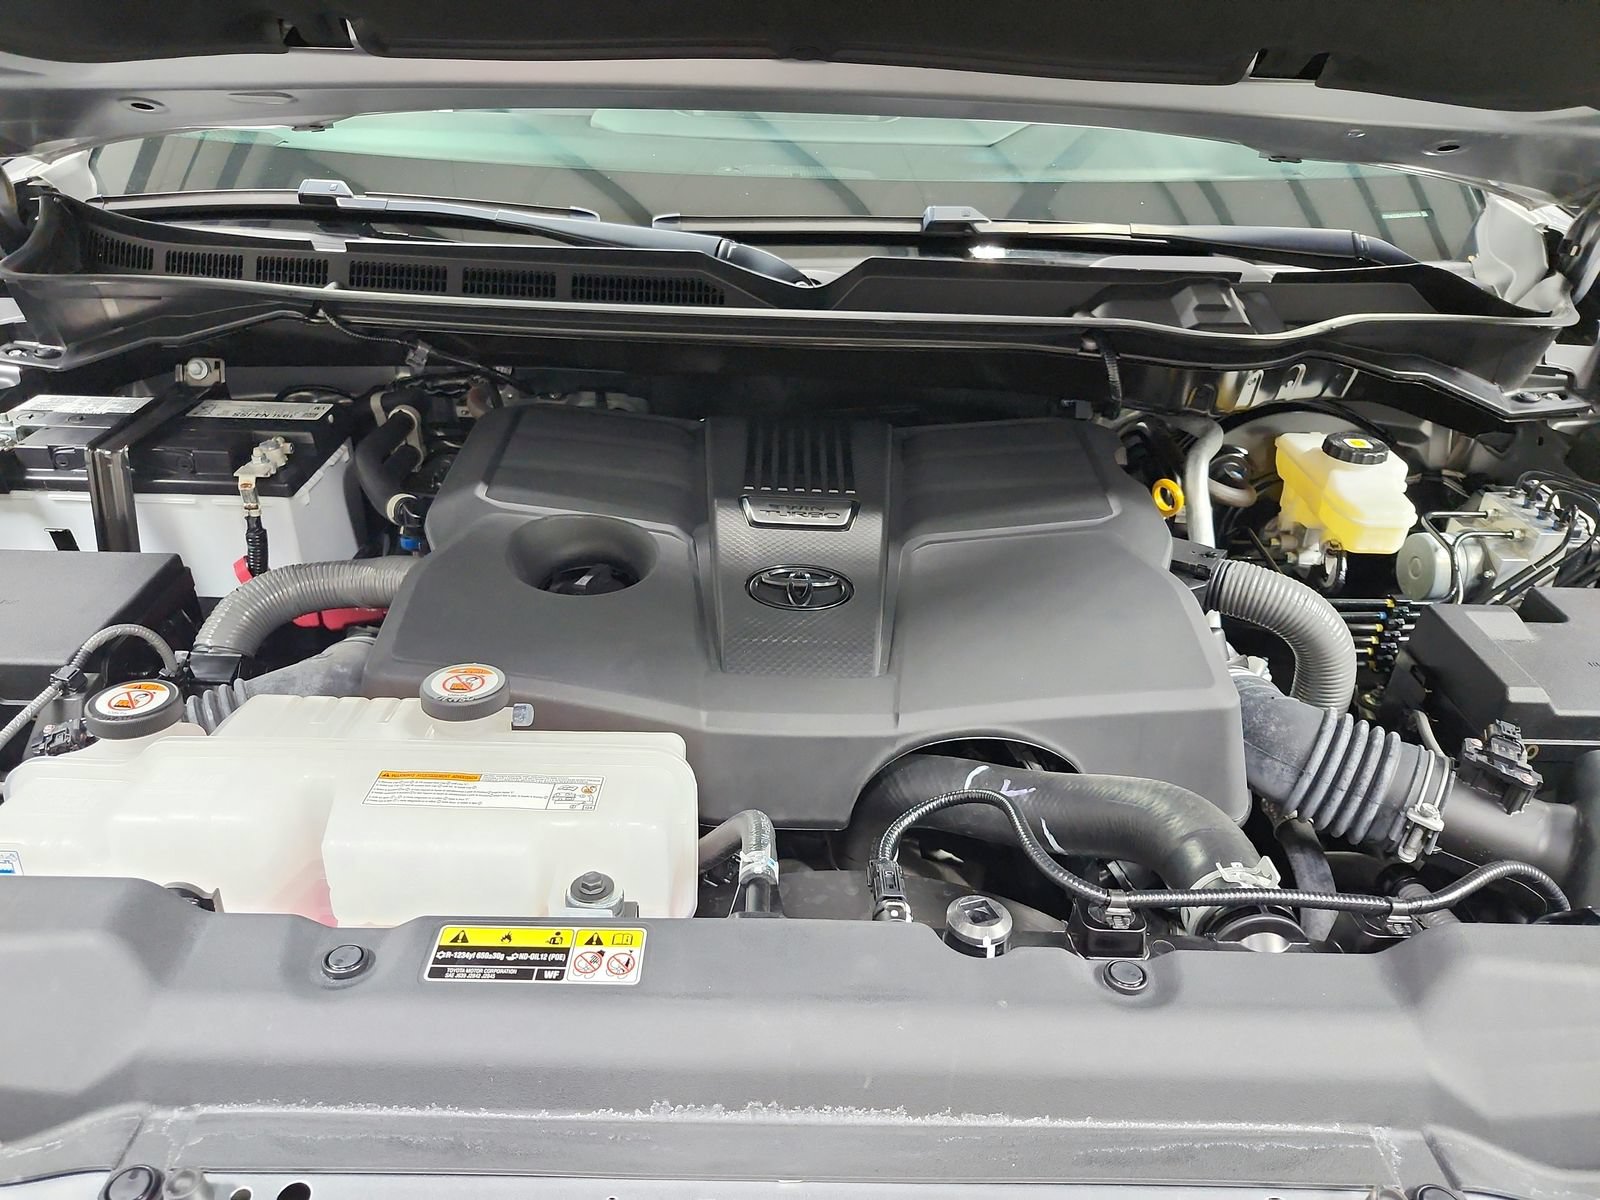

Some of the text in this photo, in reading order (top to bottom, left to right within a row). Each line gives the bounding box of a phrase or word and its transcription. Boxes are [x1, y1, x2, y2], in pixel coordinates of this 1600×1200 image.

[768, 503, 825, 511] TWIN
[759, 509, 841, 519] TURBO
[548, 952, 566, 961] (POE)
[543, 970, 560, 979] WF
